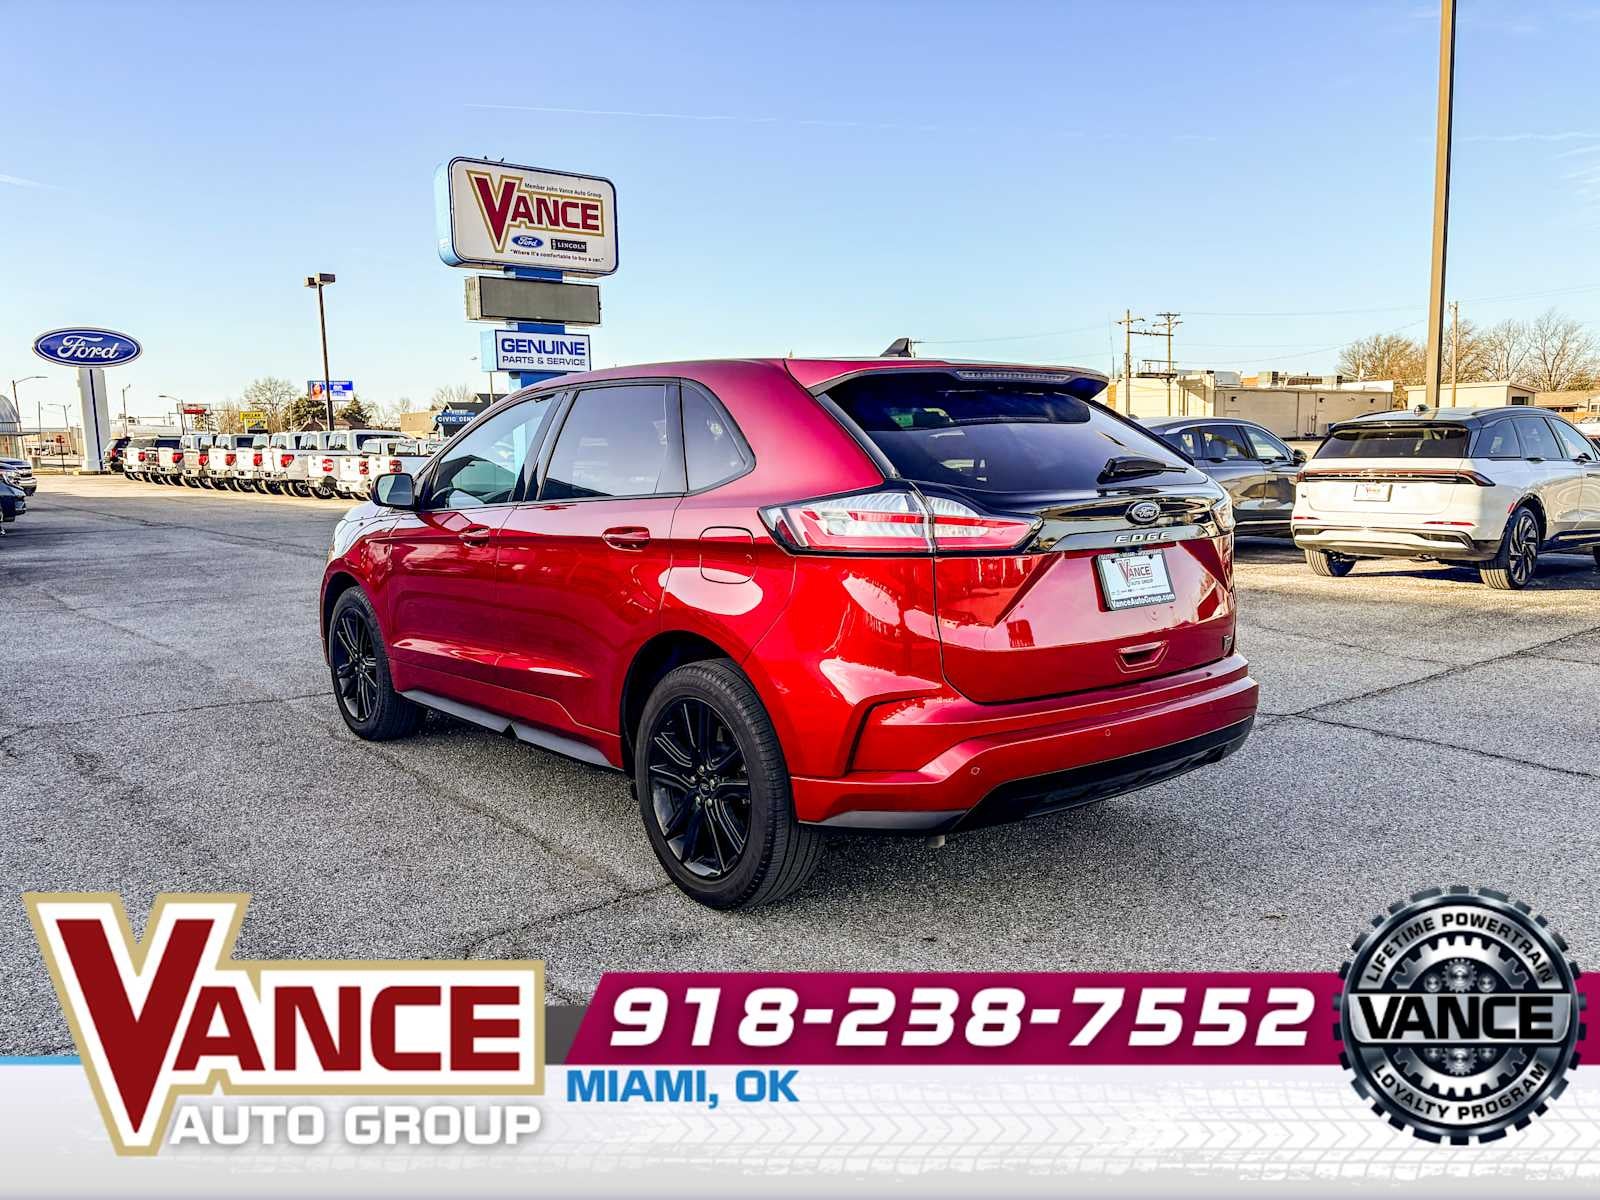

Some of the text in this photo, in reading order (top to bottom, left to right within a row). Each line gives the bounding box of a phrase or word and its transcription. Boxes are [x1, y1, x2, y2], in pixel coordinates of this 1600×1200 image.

[474, 177, 600, 246] VANCE
[517, 237, 538, 247] Ford
[557, 242, 586, 250] LINCOLN
[57, 335, 119, 359] Ford
[501, 338, 586, 356] GENUINE
[502, 356, 586, 366] PARTS & SERVICE
[1115, 531, 1170, 544] EDGE
[1117, 560, 1151, 585] VANCE
[1111, 592, 1175, 609] VanceAutoGroup.com
